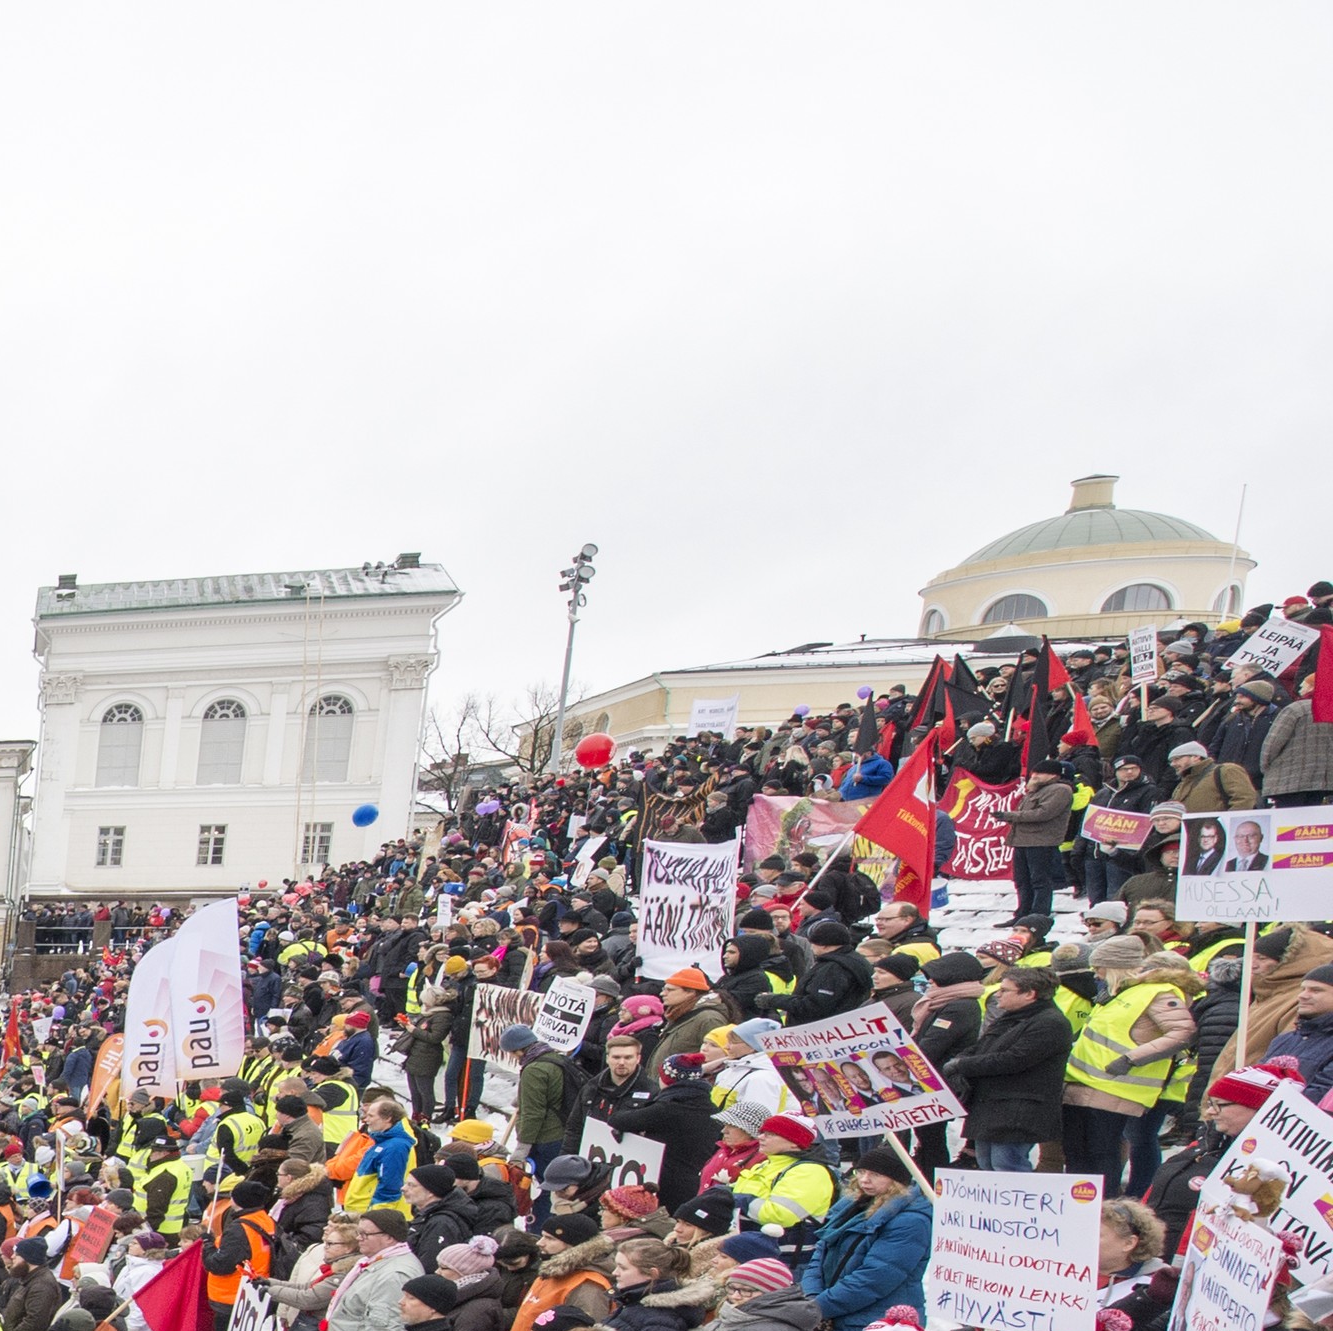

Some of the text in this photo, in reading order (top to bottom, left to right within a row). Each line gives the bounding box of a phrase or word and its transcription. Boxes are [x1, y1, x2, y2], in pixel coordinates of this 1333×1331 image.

[1258, 628, 1307, 651] LEIPÄÄ
[1261, 645, 1279, 657] JA
[1241, 650, 1284, 672] TYÖTÄ
[1185, 877, 1273, 903] KUSESSA
[550, 991, 588, 1014] TYÖTÄ
[538, 1013, 578, 1037] TURVAA
[189, 1018, 220, 1069] pau
[100, 1046, 123, 1074] JHL
[136, 1042, 161, 1087] pau
[943, 1178, 1065, 1215] TYÖMINISTERI
[1010, 1255, 1093, 1285] ODOTTAA
